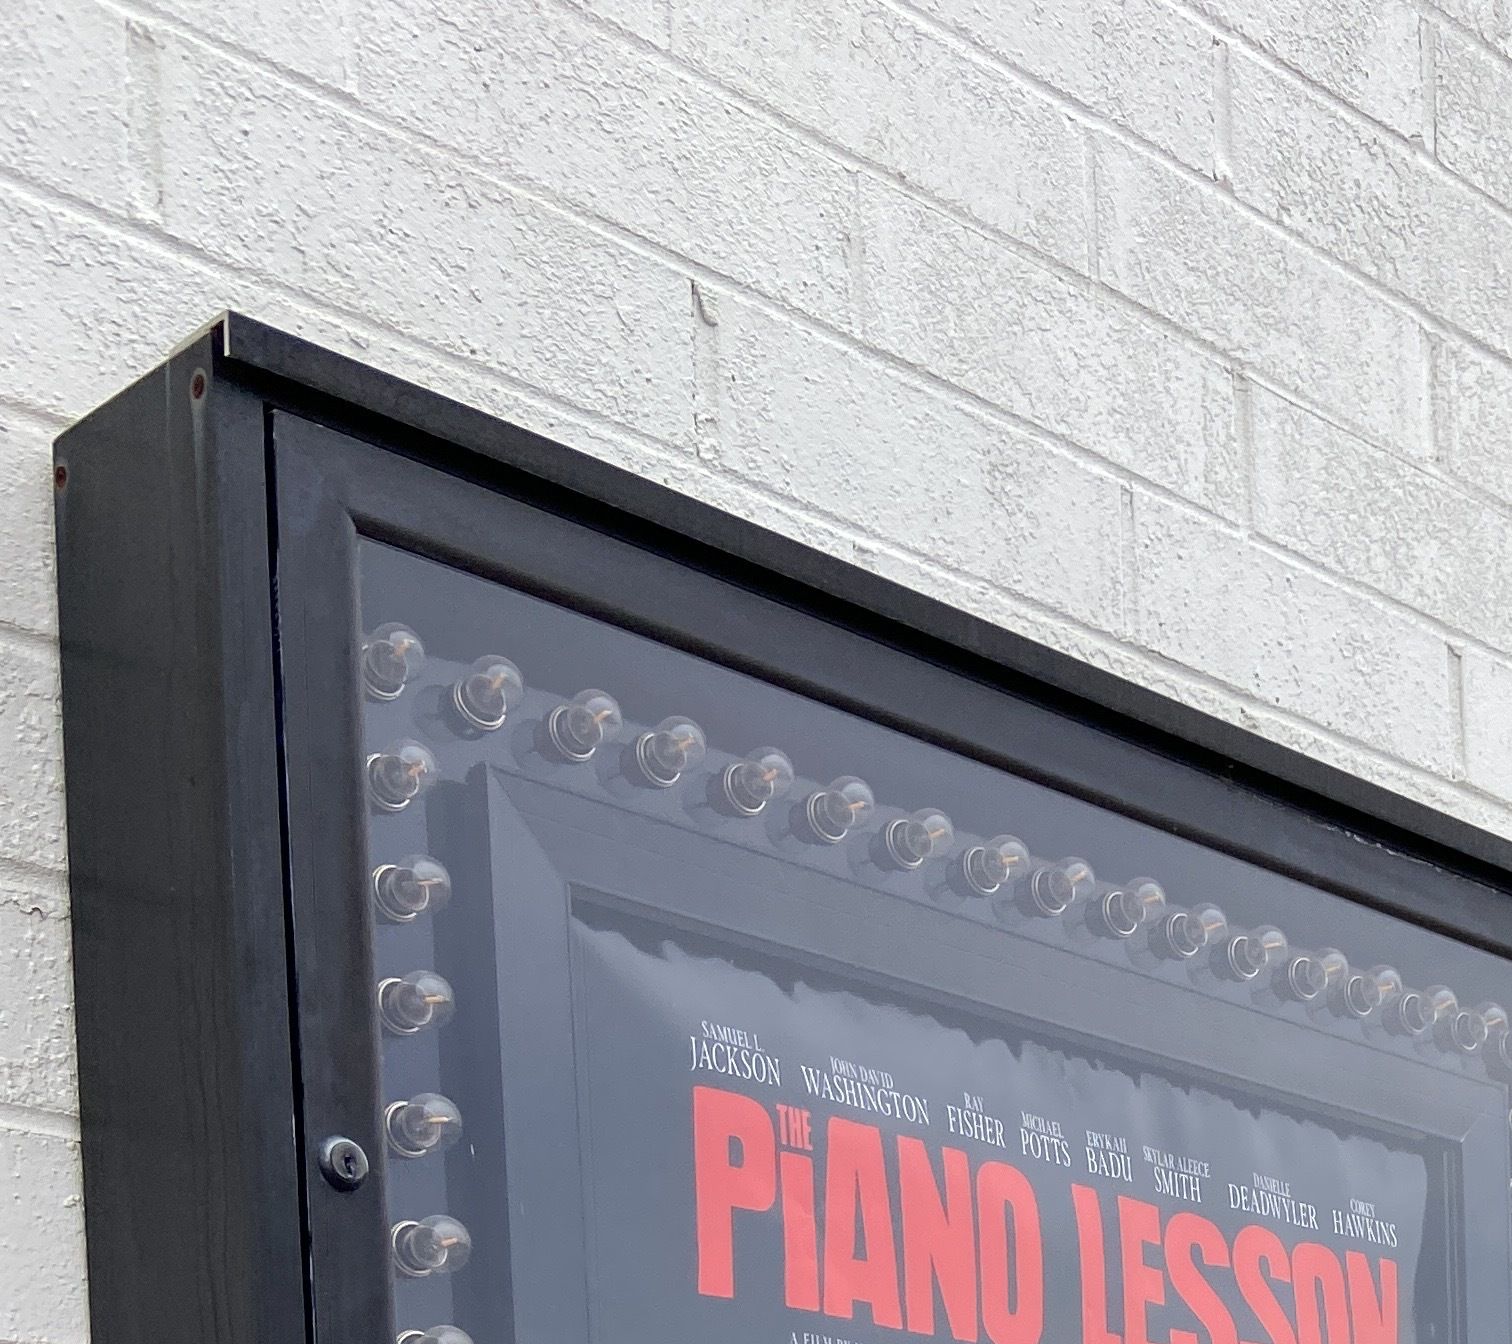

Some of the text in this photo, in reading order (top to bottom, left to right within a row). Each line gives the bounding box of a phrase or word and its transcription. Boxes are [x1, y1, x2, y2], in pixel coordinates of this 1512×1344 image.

[701, 1020, 765, 1053] SAMUEL L.
[690, 1036, 781, 1087] JACKSON
[830, 1056, 894, 1089] JOHN DAVID
[801, 1065, 930, 1125] WASHINGTON
[964, 1092, 983, 1110] RAY
[776, 1104, 813, 1150] THE
[947, 1105, 1006, 1148] FISHER
[1021, 1112, 1064, 1139] MICHAEL
[1086, 1131, 1127, 1154] ERYKAH
[1021, 1128, 1071, 1167] POTTS
[1086, 1146, 1132, 1182] BADU
[1143, 1145, 1210, 1179] SKYLAR ALEECE
[1155, 1166, 1201, 1202] SMITH
[1253, 1173, 1291, 1198] DANIELLE
[1229, 1184, 1319, 1229] DEADWYLER
[1350, 1198, 1375, 1218] COREY
[1333, 1210, 1397, 1248] HAWKINS
